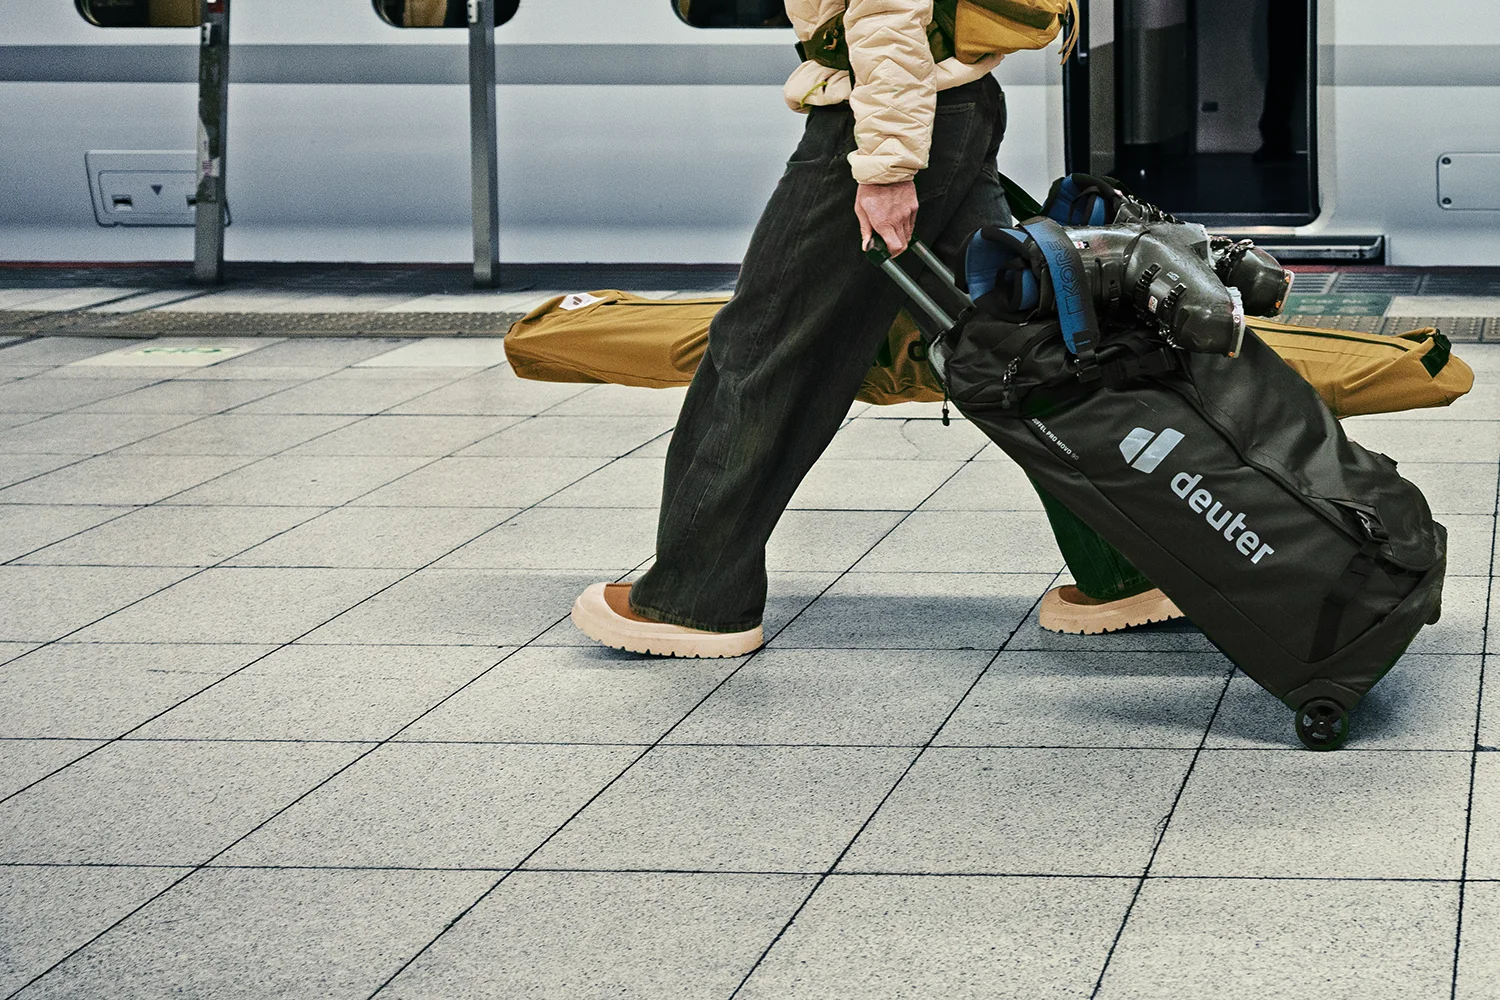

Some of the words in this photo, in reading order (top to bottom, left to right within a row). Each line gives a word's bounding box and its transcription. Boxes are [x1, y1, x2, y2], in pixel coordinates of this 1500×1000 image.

[1046, 430, 1058, 442] PRO
[1056, 440, 1072, 455] MOVO
[1170, 471, 1275, 565] deuter
